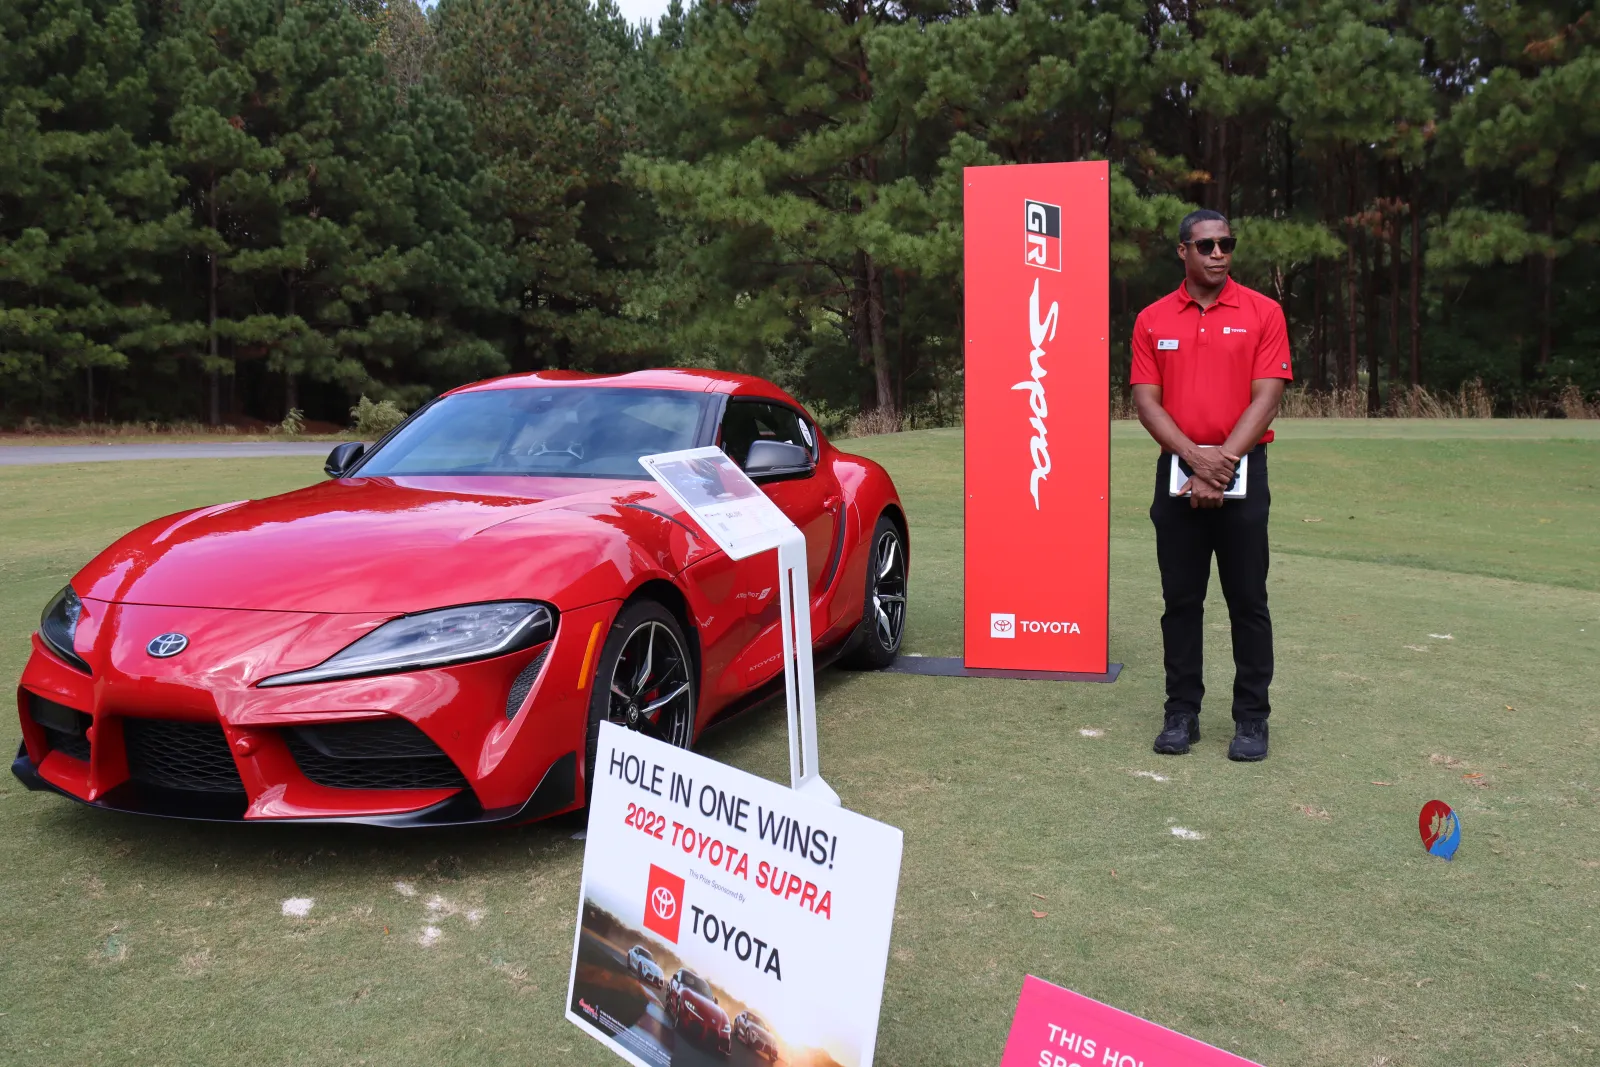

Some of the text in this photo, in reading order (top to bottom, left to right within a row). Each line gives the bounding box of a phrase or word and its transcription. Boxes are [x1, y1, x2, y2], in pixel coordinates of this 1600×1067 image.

[1011, 203, 1059, 511] GR Supra
[1020, 620, 1080, 634] TOYOTA
[610, 747, 838, 869] HOLE IN ONE WINS!
[625, 802, 832, 921] 2022 TOYOTA SUPRA
[690, 868, 747, 904] This Prize Sponsored By
[691, 904, 782, 982] TOYOTA
[1038, 1049, 1081, 1067] SP
[1047, 1023, 1097, 1059] THIS
